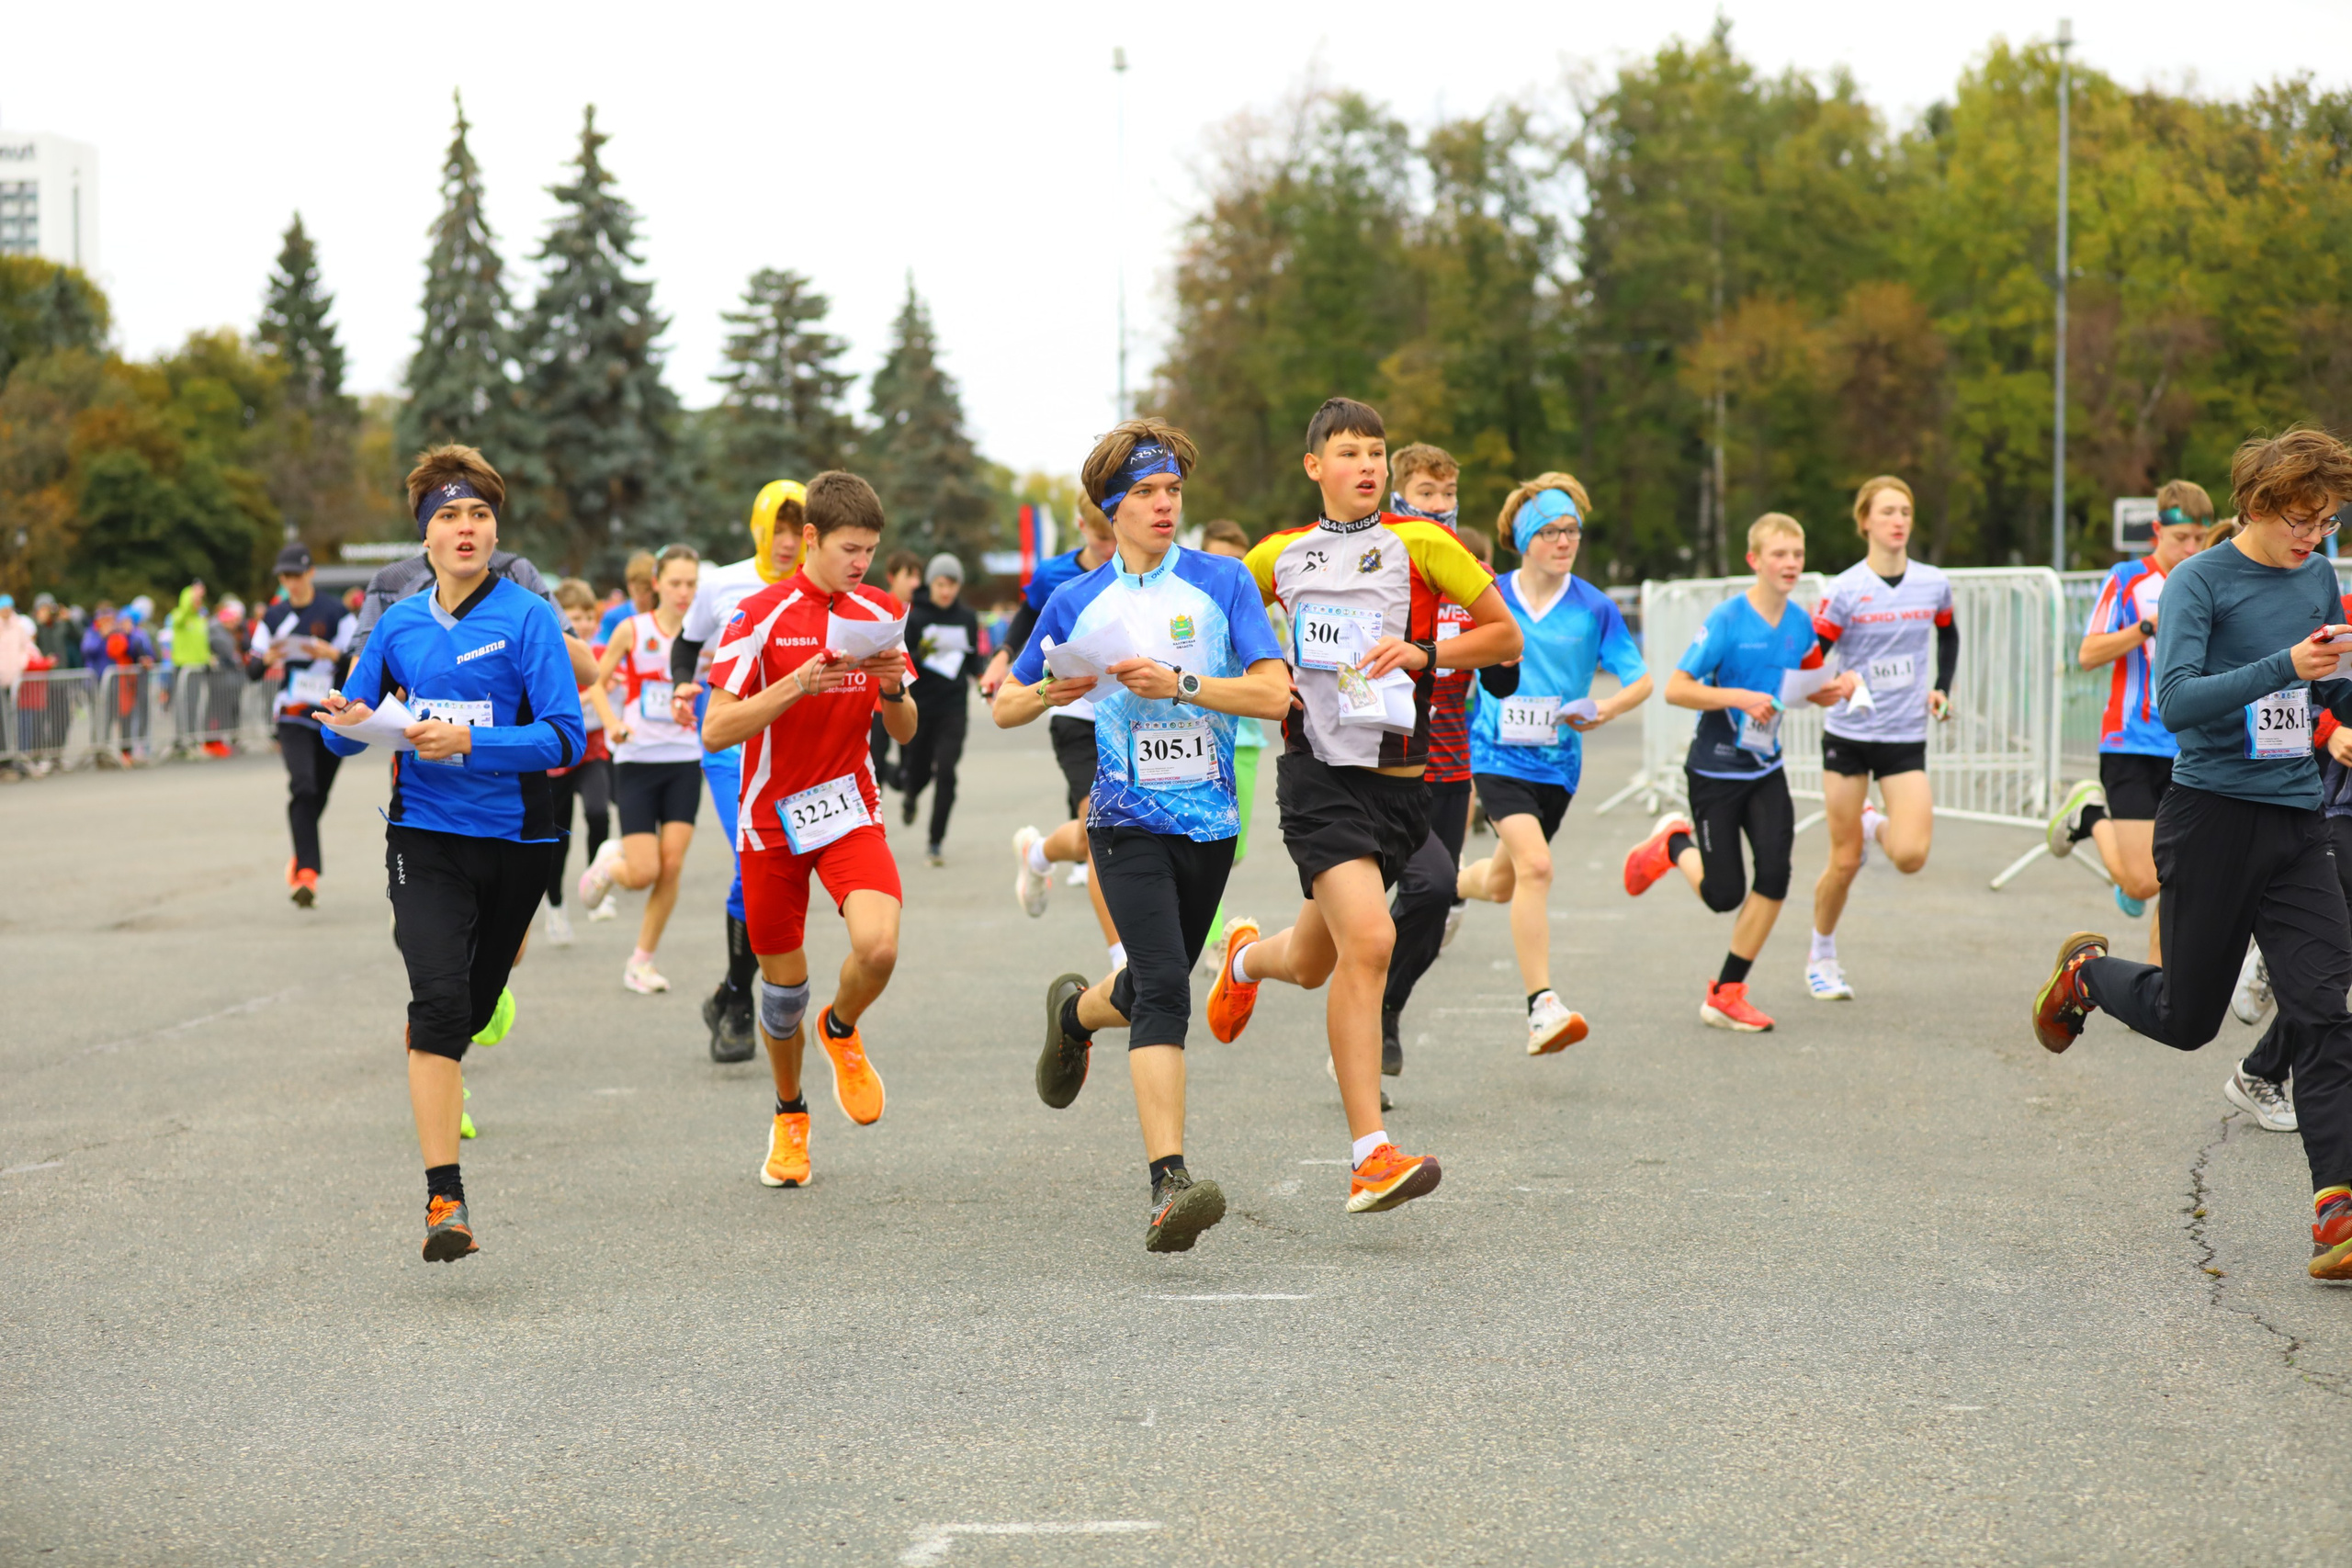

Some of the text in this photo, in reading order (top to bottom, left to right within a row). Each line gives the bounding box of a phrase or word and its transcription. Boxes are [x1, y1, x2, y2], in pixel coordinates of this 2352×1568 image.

[1318, 515, 1344, 531] US46
[1851, 611, 1896, 625] NORD
[457, 639, 506, 665] noname
[775, 637, 819, 647] RUSSIA
[1871, 660, 1912, 680] 361.1
[823, 684, 866, 694] tchsport.ru
[1503, 707, 1551, 727] 331.1
[2258, 706, 2306, 731] 328.1
[1138, 735, 1204, 762] 305.1
[792, 793, 851, 829] 322.1
